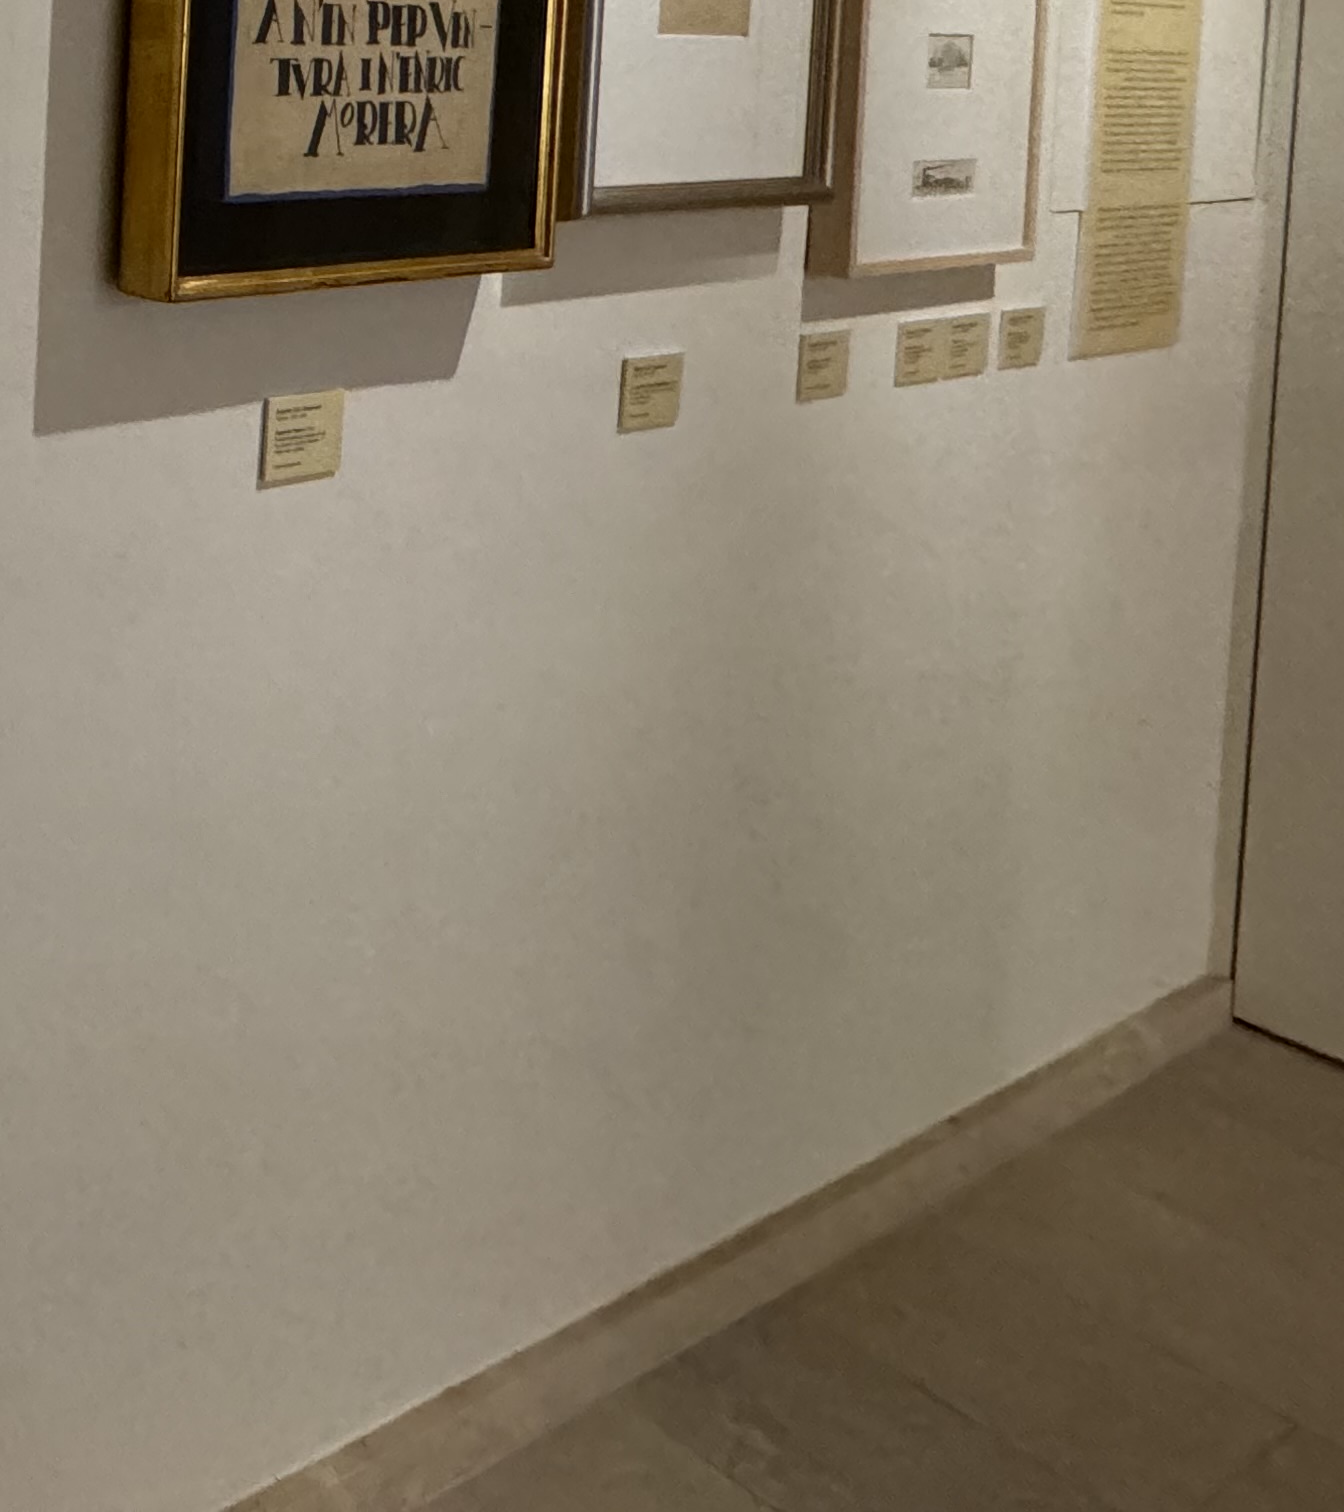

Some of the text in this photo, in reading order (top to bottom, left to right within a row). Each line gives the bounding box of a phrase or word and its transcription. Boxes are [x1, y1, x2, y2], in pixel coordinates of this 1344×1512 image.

[366, 0, 428, 47] PEP
[359, 57, 372, 92] I
[303, 94, 450, 157] MORERA
